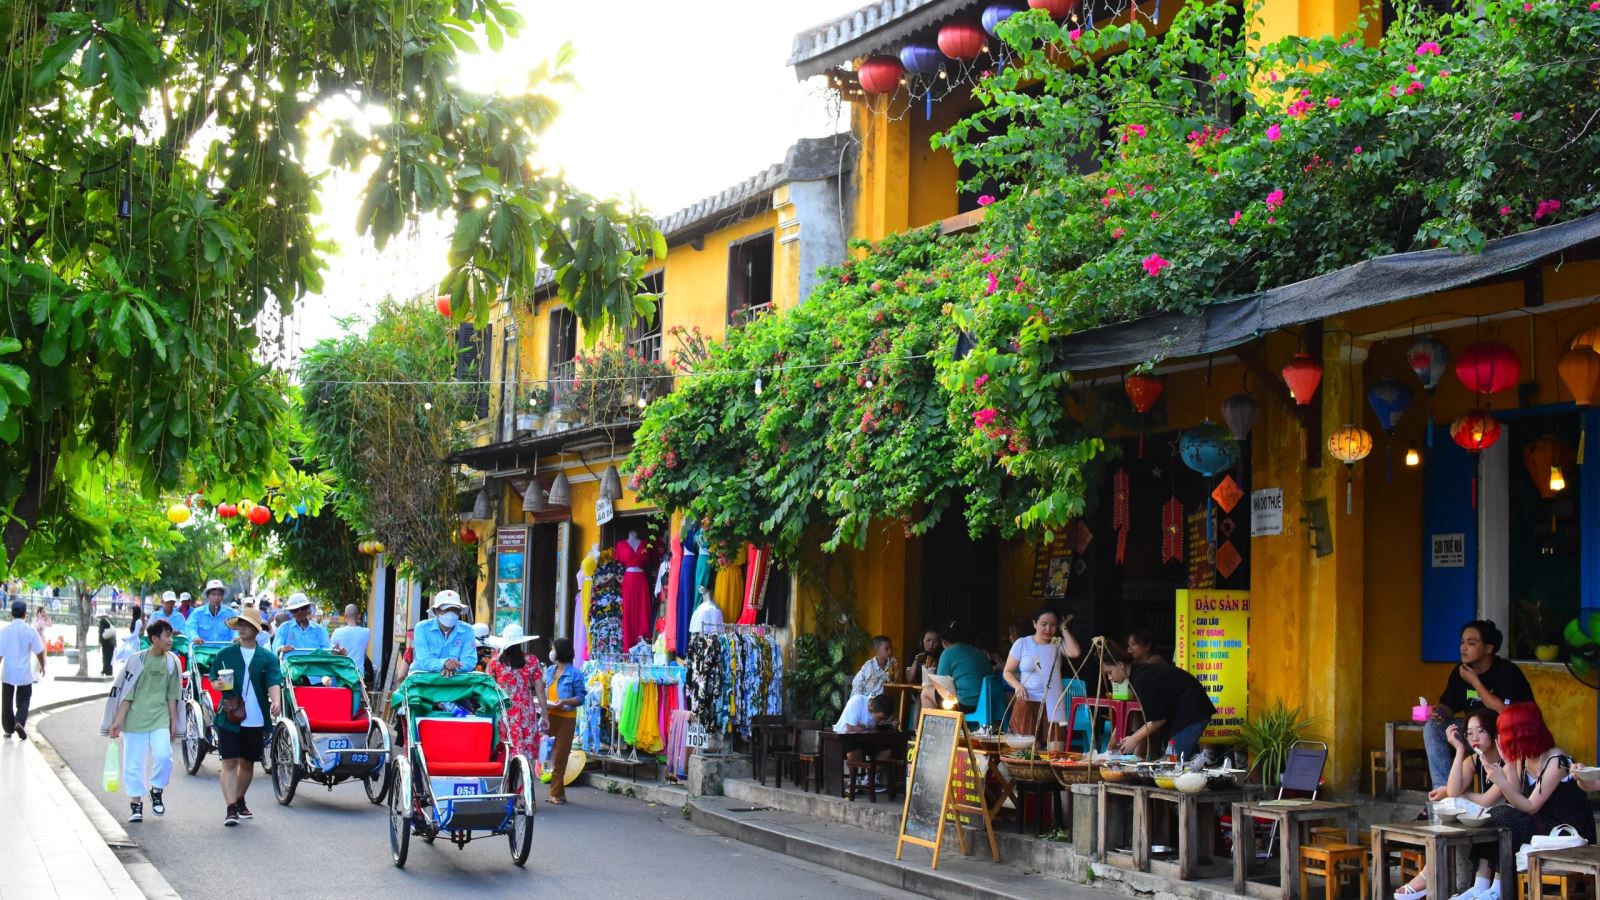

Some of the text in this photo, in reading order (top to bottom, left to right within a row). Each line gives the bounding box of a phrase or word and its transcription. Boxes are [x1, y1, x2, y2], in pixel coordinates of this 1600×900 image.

[1242, 599, 1251, 611] H
[330, 740, 348, 749] 023
[352, 753, 369, 762] 023
[456, 785, 476, 796] 053
